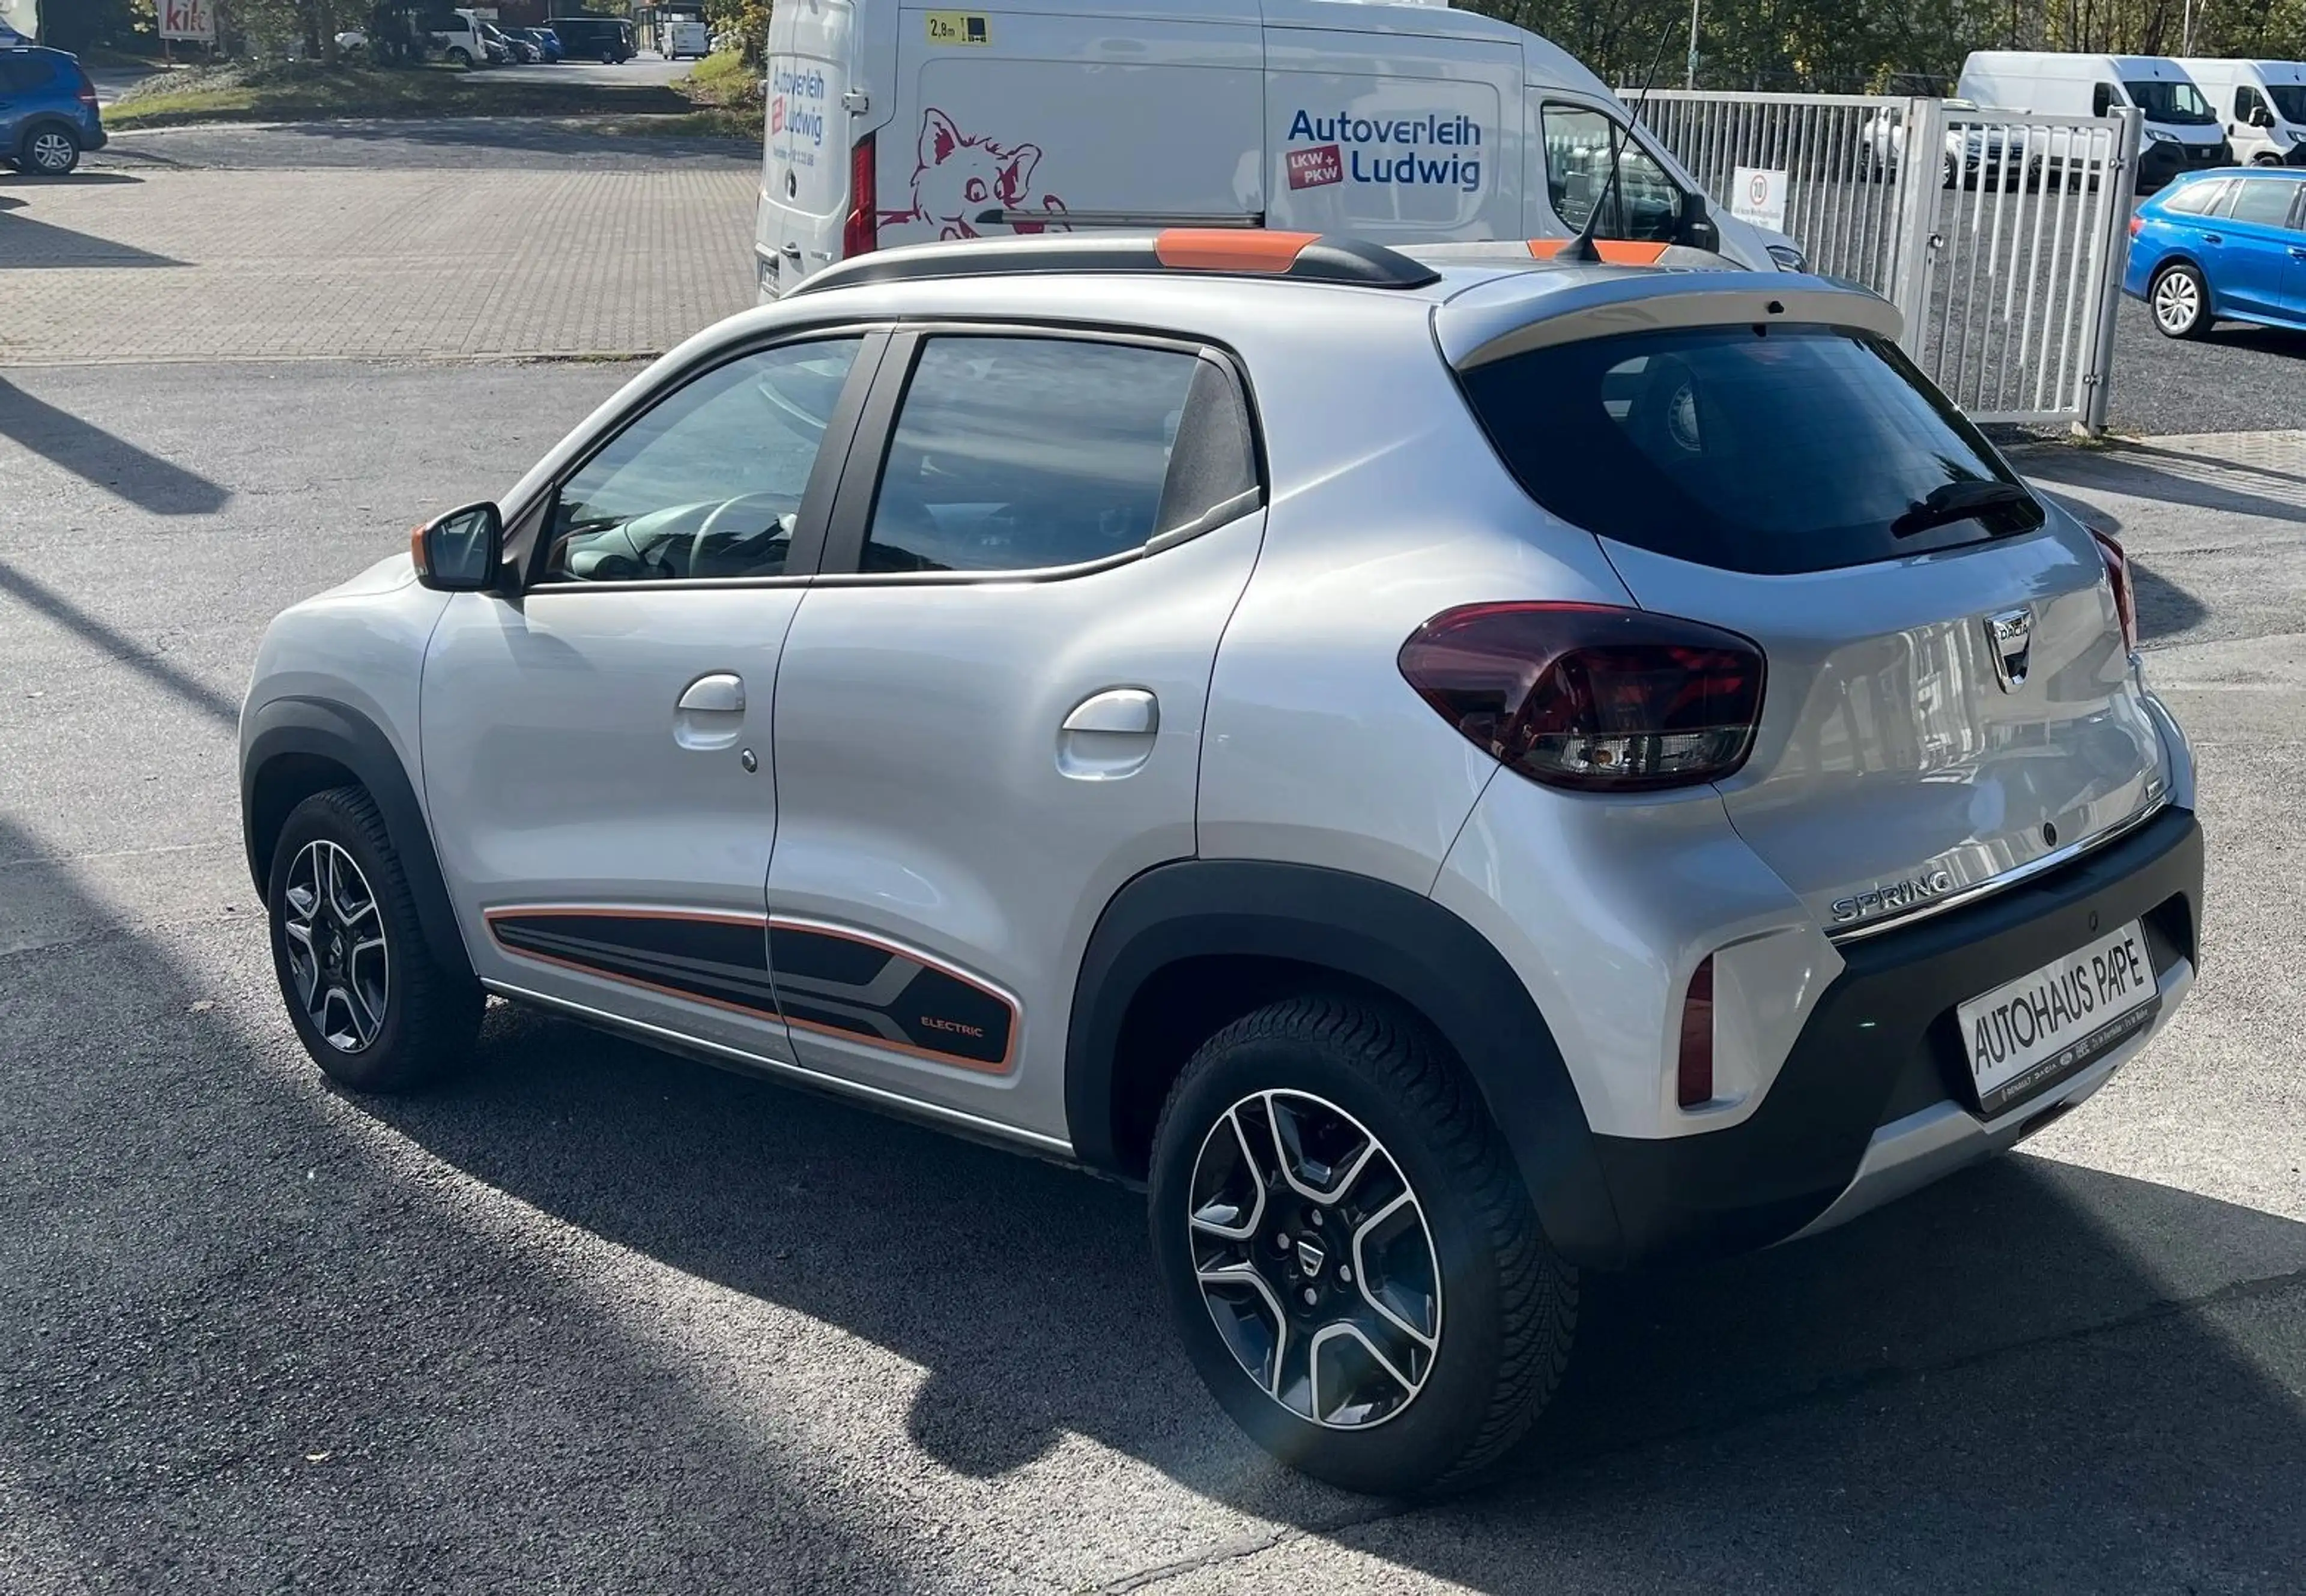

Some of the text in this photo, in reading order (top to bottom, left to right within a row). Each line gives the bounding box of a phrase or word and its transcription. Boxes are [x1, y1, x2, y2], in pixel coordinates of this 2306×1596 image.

[1288, 109, 1481, 145] Autoverleih
[1304, 165, 1338, 183] PKW
[1352, 151, 1480, 192] Ludwig
[1832, 871, 1949, 922] SPRING
[1975, 966, 2094, 1075] AUTOHAUS
[2092, 938, 2144, 1006] PAPE
[921, 1016, 984, 1038] ELECTRIC
